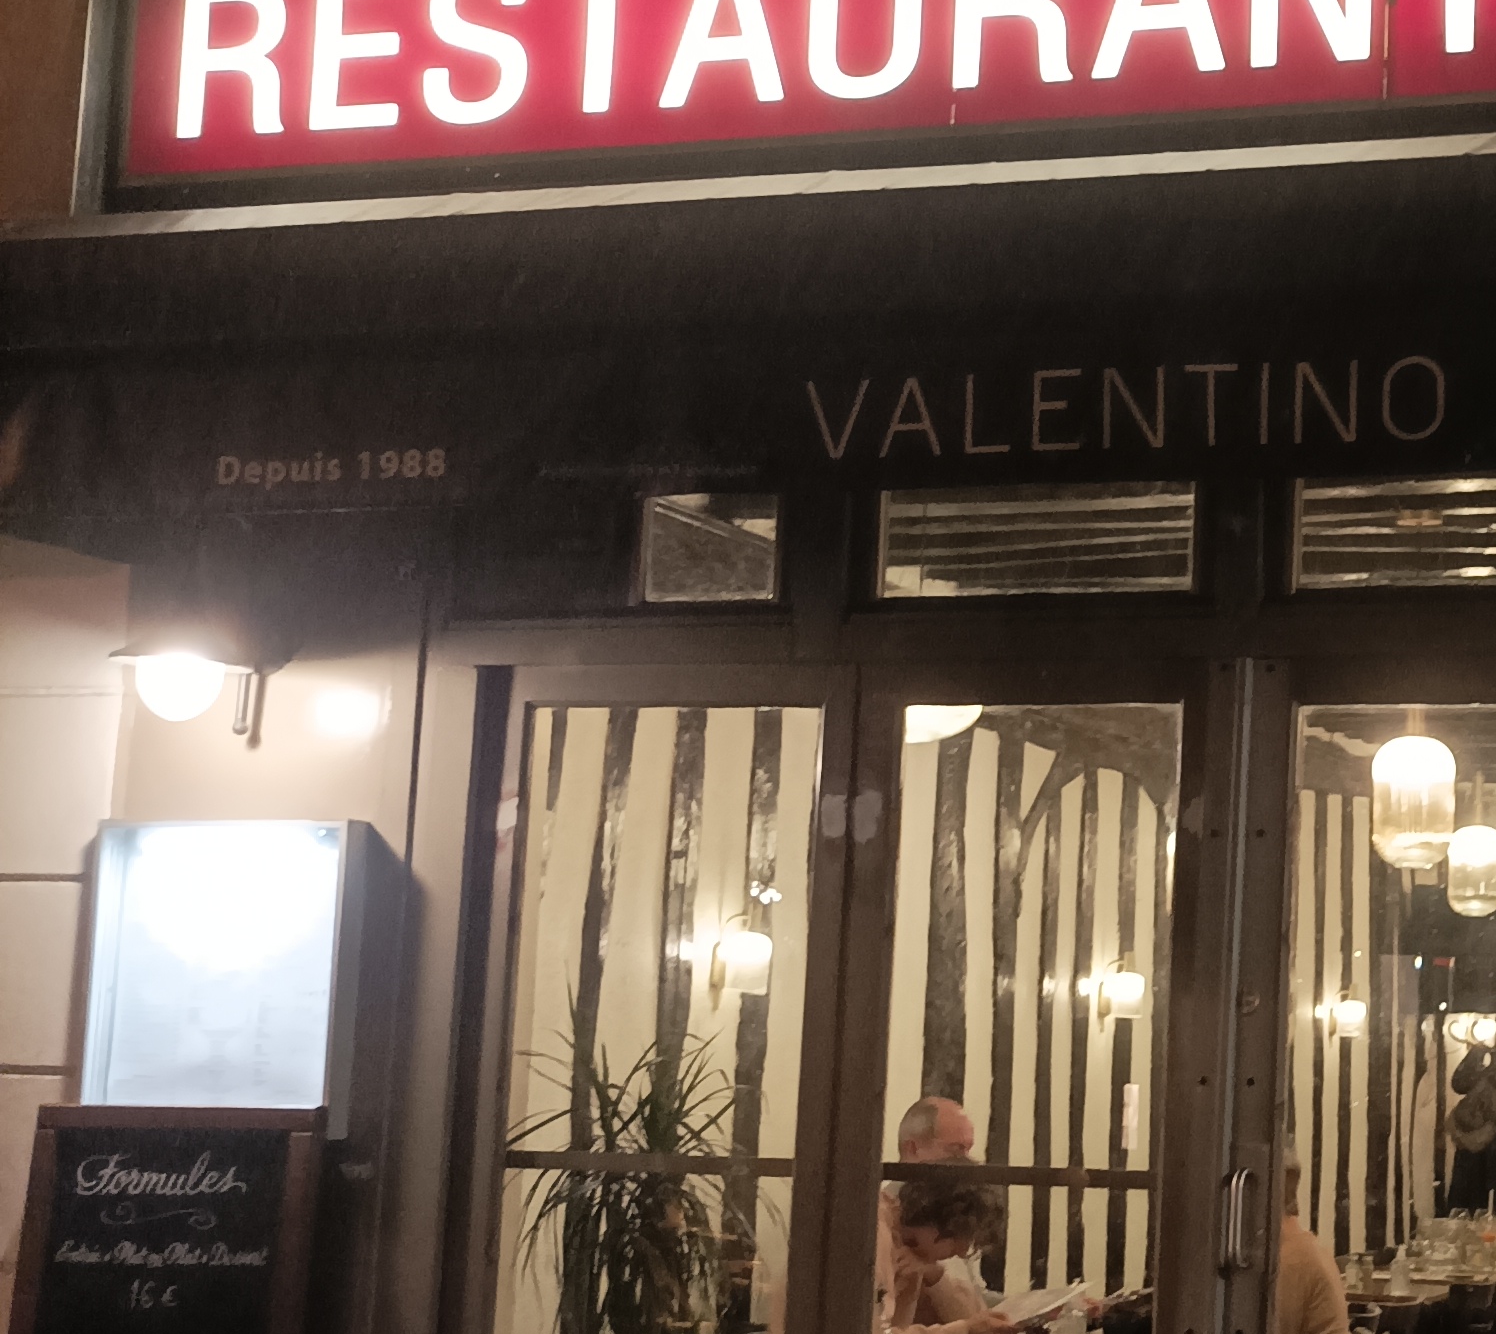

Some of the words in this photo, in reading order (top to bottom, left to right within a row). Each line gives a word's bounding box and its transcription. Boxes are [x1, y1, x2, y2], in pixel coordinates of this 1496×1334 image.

[806, 353, 1447, 463] VALENTINO
[215, 450, 343, 491] Depuis
[357, 445, 449, 482] 1988
[76, 1149, 247, 1197] Formules
